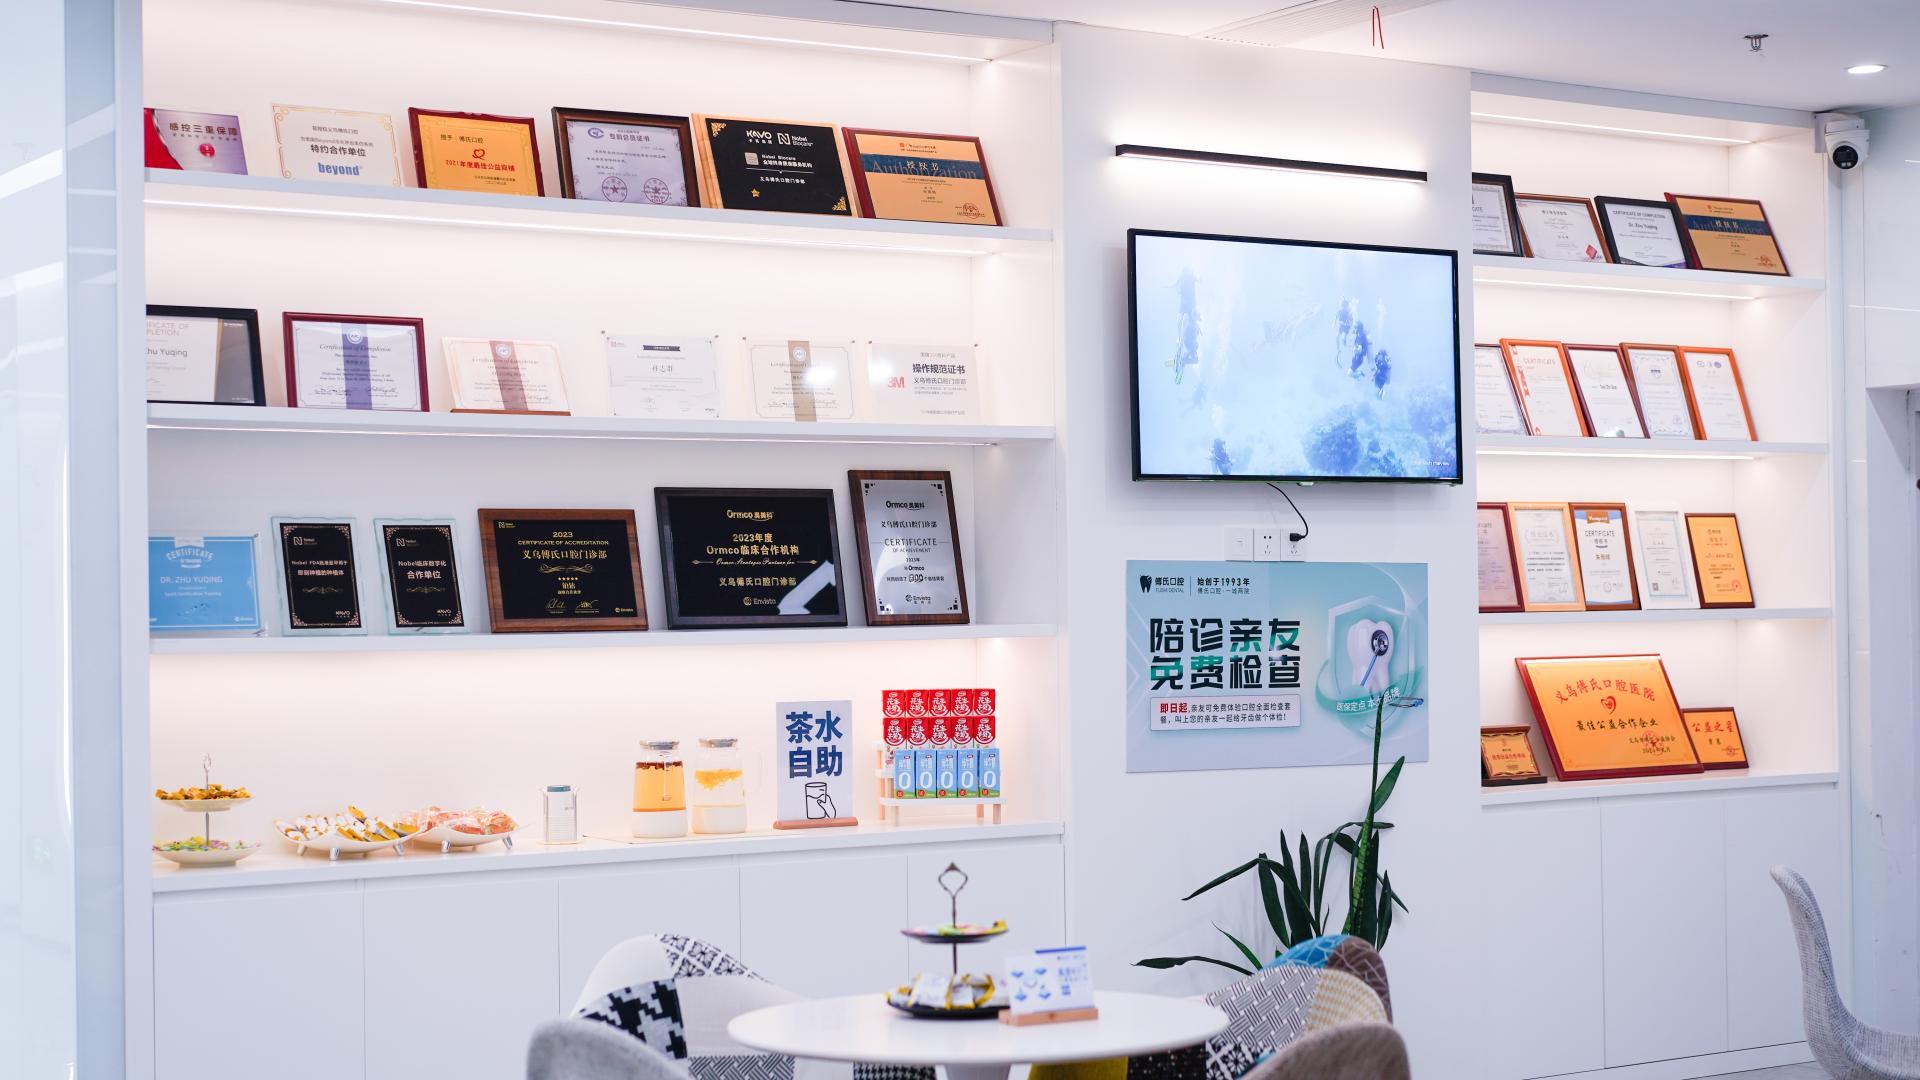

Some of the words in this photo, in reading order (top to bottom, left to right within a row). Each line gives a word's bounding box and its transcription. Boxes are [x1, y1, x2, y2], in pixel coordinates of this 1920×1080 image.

[746, 130, 772, 139] KAVO
[310, 144, 366, 156] 特约合作单位
[318, 162, 360, 176] beyond
[912, 363, 966, 374] 操作规范证书
[888, 376, 905, 388] 3M
[726, 510, 753, 519] Ormco
[732, 533, 773, 543] 2023年度
[706, 545, 800, 555] Ormco临床合作机构
[407, 570, 441, 579] 合作单位
[719, 577, 797, 587] 义乌傅氏口腔门诊部
[1155, 577, 1185, 586] 傅氏口腔
[1197, 577, 1250, 587] 始创于1993年
[1150, 618, 1300, 653] 陪诊亲友
[1150, 655, 1300, 691] 免费检查
[1556, 678, 1656, 704] 义乌傅氏口腔医院
[786, 710, 843, 743] 茶水
[1576, 718, 1658, 731] 最佳公益合作企业
[1692, 721, 1734, 732] 公益之星
[789, 745, 843, 778] 自助
